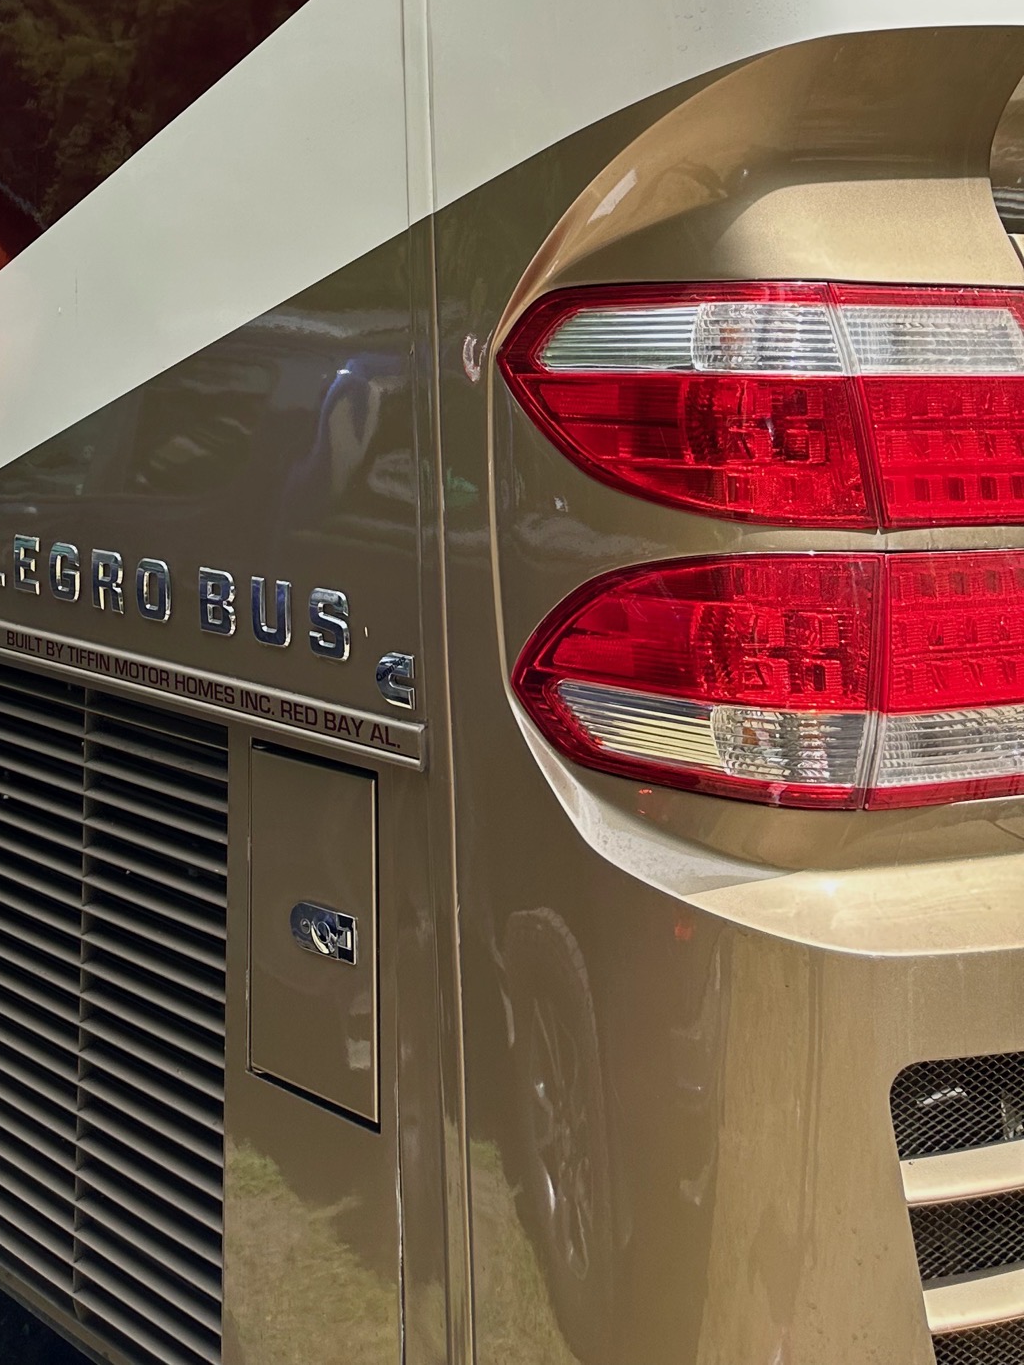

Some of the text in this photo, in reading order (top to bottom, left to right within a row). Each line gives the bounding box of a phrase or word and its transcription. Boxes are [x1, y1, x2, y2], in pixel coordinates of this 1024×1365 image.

[199, 566, 351, 662] BUS
[6, 630, 401, 749] BUILT BY TIFFIN MOTOR HOMES INC. RED BAY AL.
